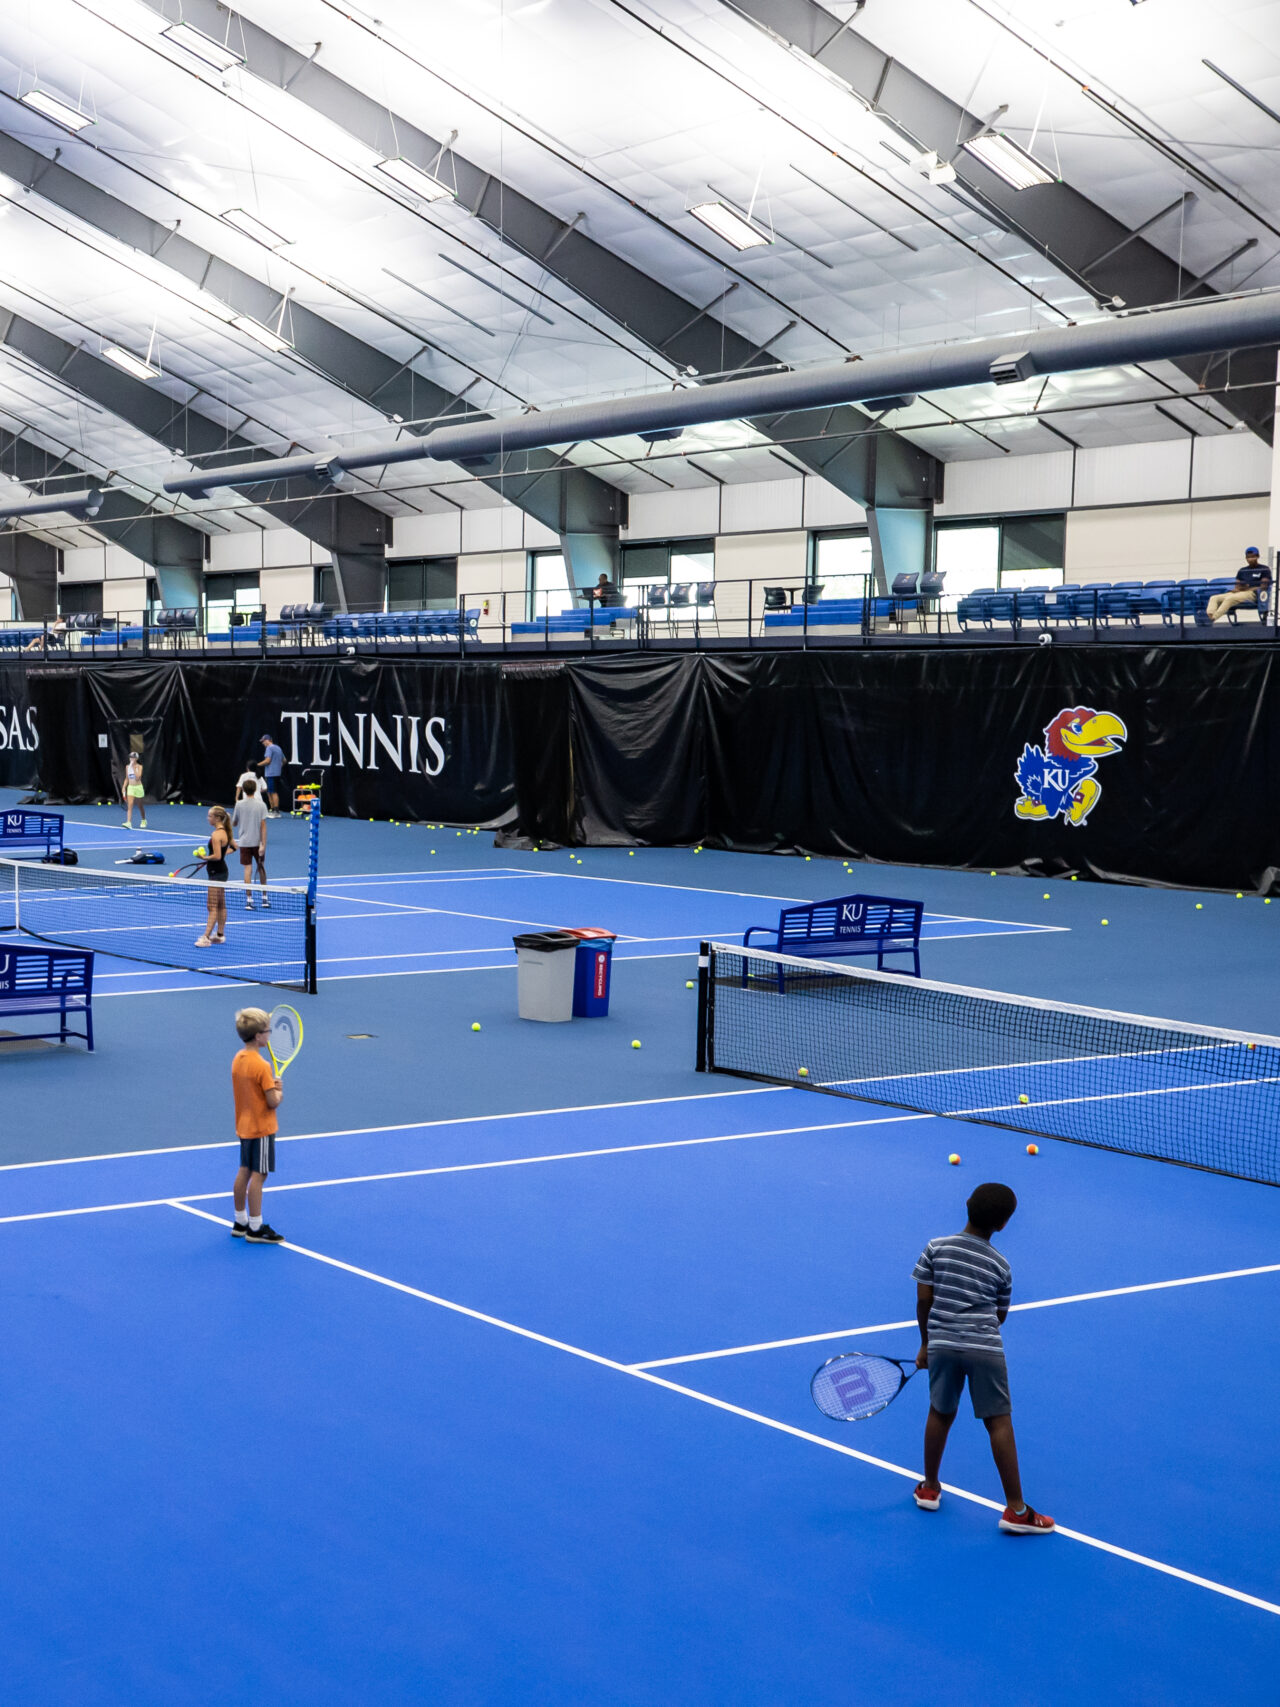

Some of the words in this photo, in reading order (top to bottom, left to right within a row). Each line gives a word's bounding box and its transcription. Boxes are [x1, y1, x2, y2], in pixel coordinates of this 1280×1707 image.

[280, 710, 446, 777] TENNIS
[1043, 768, 1070, 791] KU
[7, 814, 22, 827] KU
[841, 903, 863, 922] KU
[839, 925, 861, 934] TENNIS
